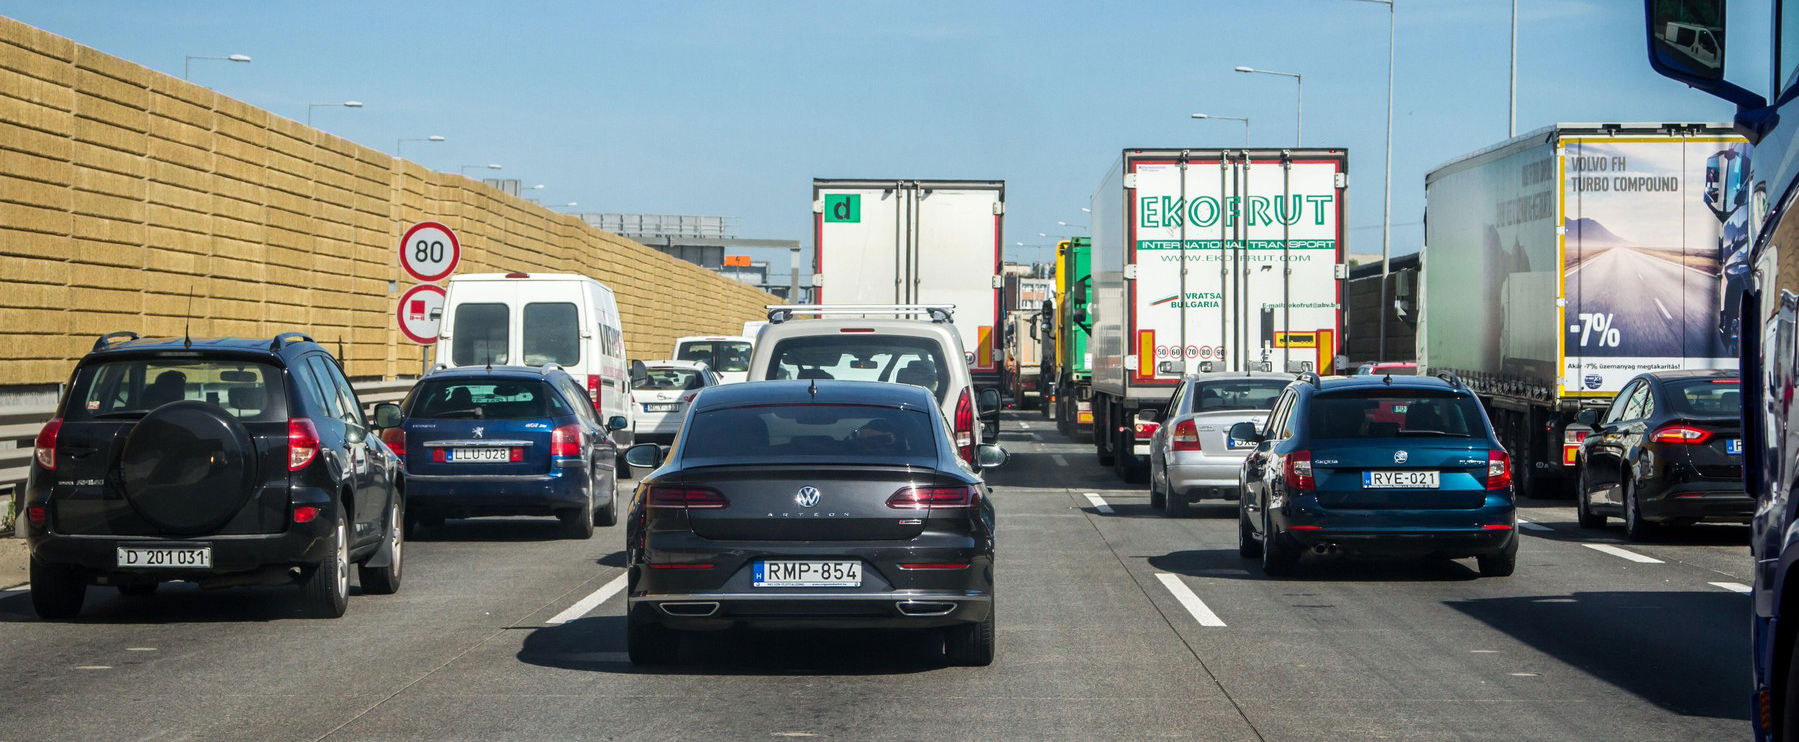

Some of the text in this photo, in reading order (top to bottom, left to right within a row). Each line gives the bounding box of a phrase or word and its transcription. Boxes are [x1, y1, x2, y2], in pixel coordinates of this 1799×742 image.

[1571, 156, 1626, 172] VOLVO FH
[1571, 176, 1678, 192] TURBO COMPOUND
[833, 195, 851, 221] d
[1140, 194, 1333, 228] EKOFRUT
[414, 240, 444, 263] 80
[1142, 240, 1335, 249] INTERNATIONAL TRANSPORT
[1569, 312, 1621, 347] -7%
[455, 448, 506, 460] LLU-028
[1374, 472, 1434, 484] RYE-021
[127, 550, 138, 564] D
[768, 562, 857, 580] RMP-854
